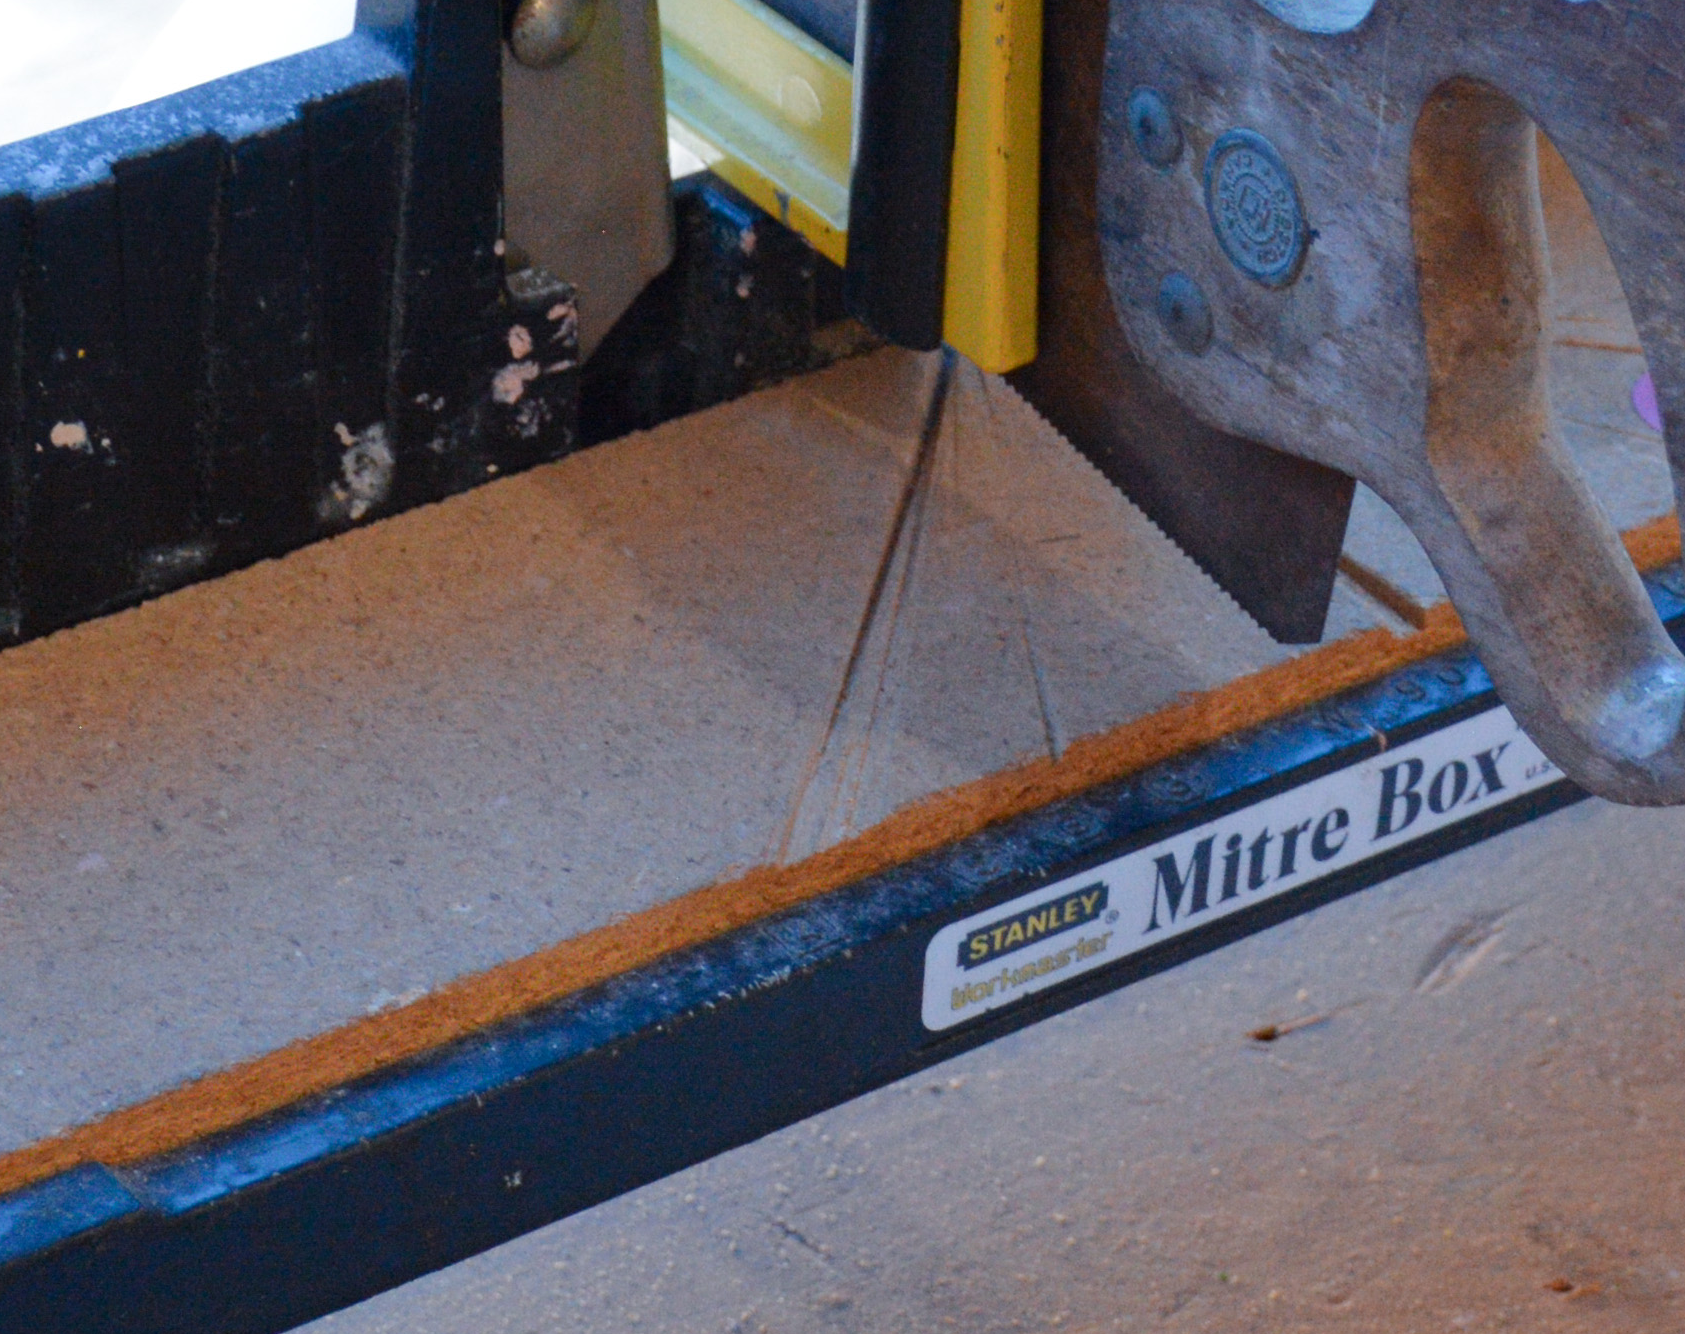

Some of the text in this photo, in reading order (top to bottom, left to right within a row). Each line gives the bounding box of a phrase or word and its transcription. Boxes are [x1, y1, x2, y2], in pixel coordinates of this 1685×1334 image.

[1142, 740, 1512, 935] Mitre Box
[969, 890, 1100, 961] STANLEY
